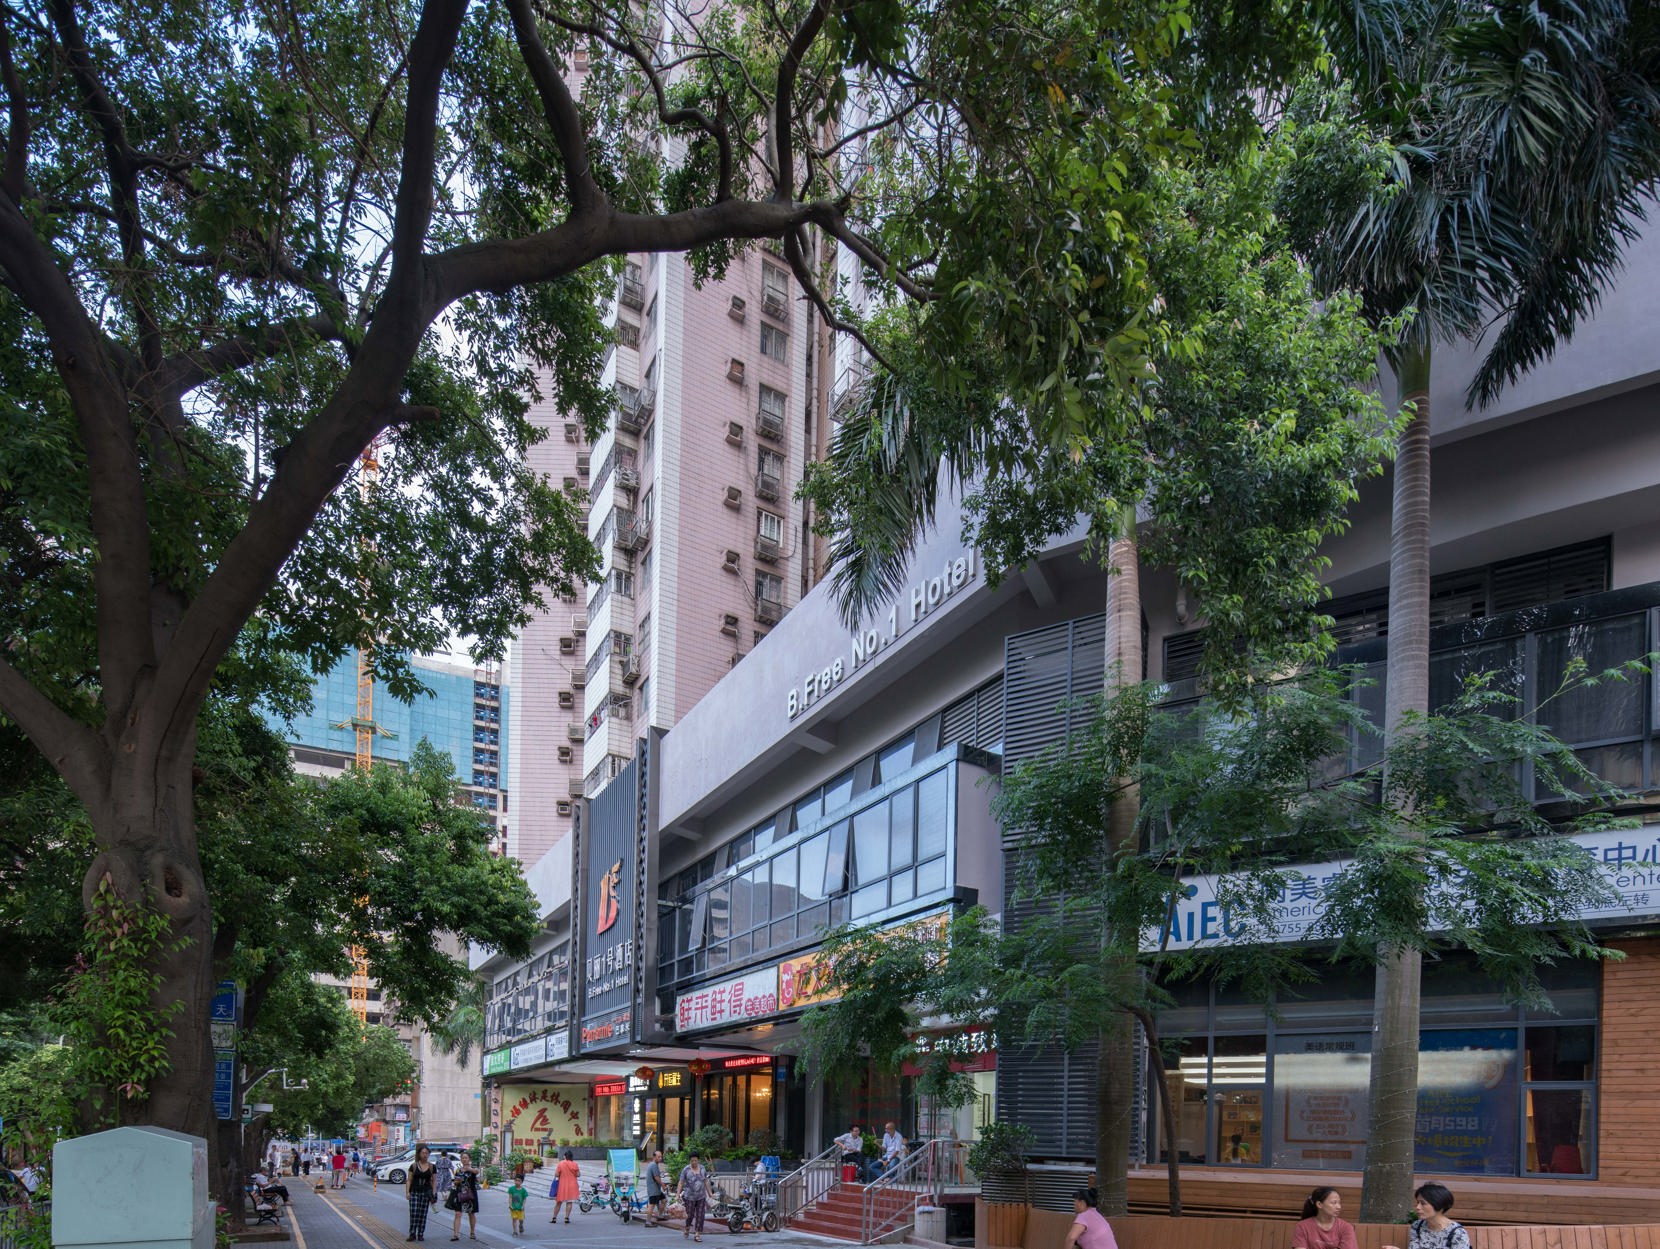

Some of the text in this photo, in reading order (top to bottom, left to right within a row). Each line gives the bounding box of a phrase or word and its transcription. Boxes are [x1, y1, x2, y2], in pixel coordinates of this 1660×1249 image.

[788, 545, 977, 719] B.Free No.1 Hotel
[680, 981, 744, 1029] 鲜来鲜得
